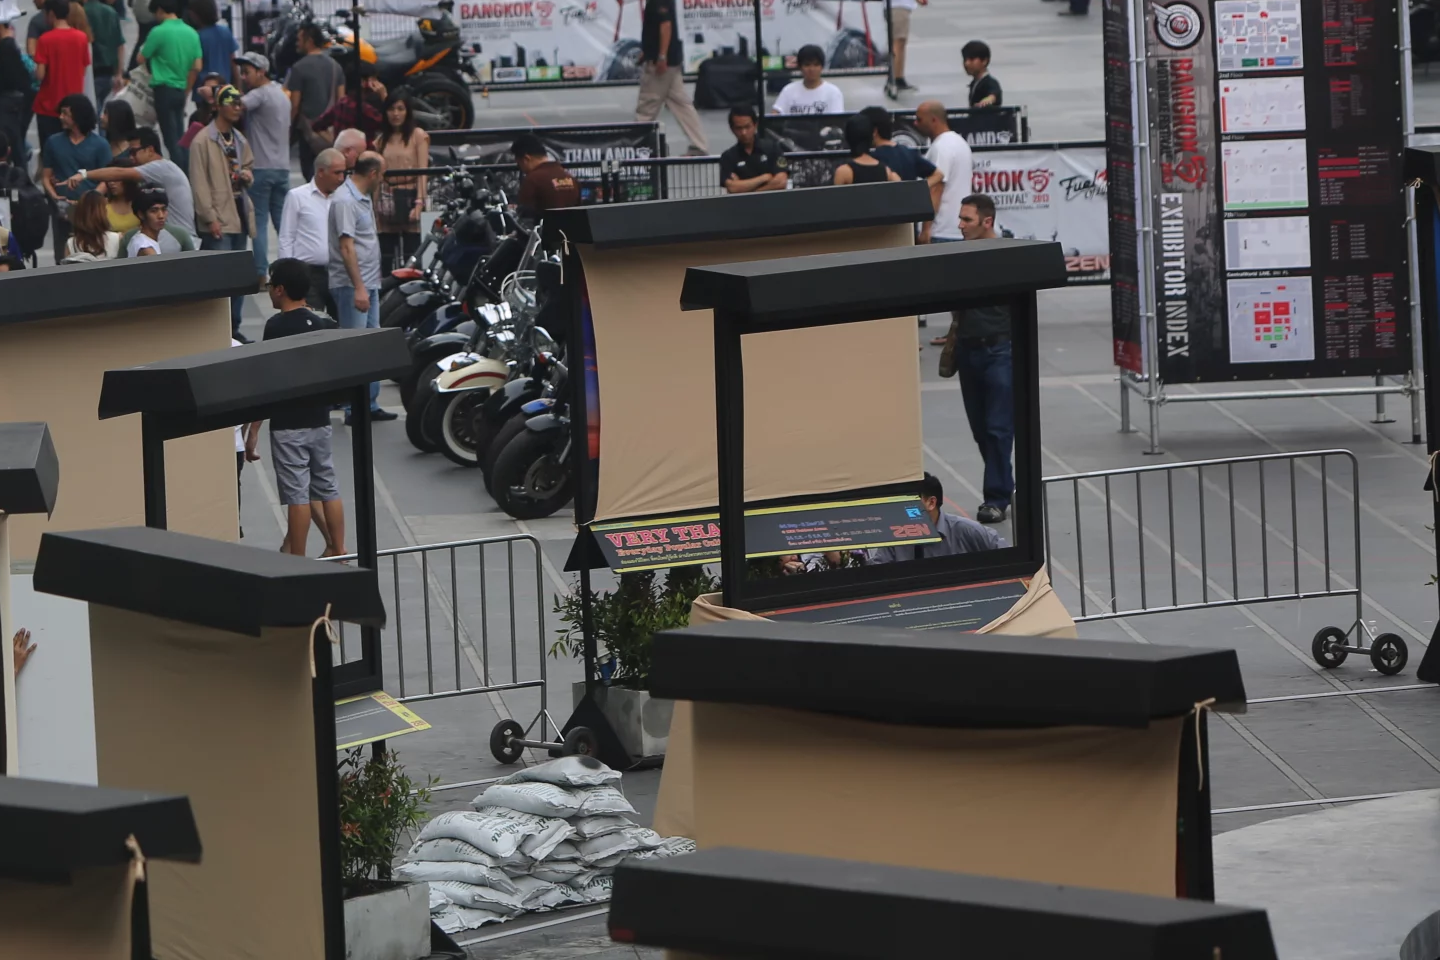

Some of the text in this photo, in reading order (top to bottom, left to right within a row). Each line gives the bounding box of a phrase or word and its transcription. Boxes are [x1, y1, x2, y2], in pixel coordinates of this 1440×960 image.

[460, 1, 534, 20] BANGKOK
[1169, 58, 1199, 155] BANGKOK
[562, 147, 636, 163] THAILAND
[971, 169, 1025, 194] GKOK
[1065, 255, 1111, 271] ZEN
[1160, 192, 1190, 358] EXHIBITOR INDEX
[605, 522, 720, 548] VERY THA
[889, 523, 931, 538] ZEN
[616, 545, 664, 557] Everyday
[665, 540, 702, 553] Popular
